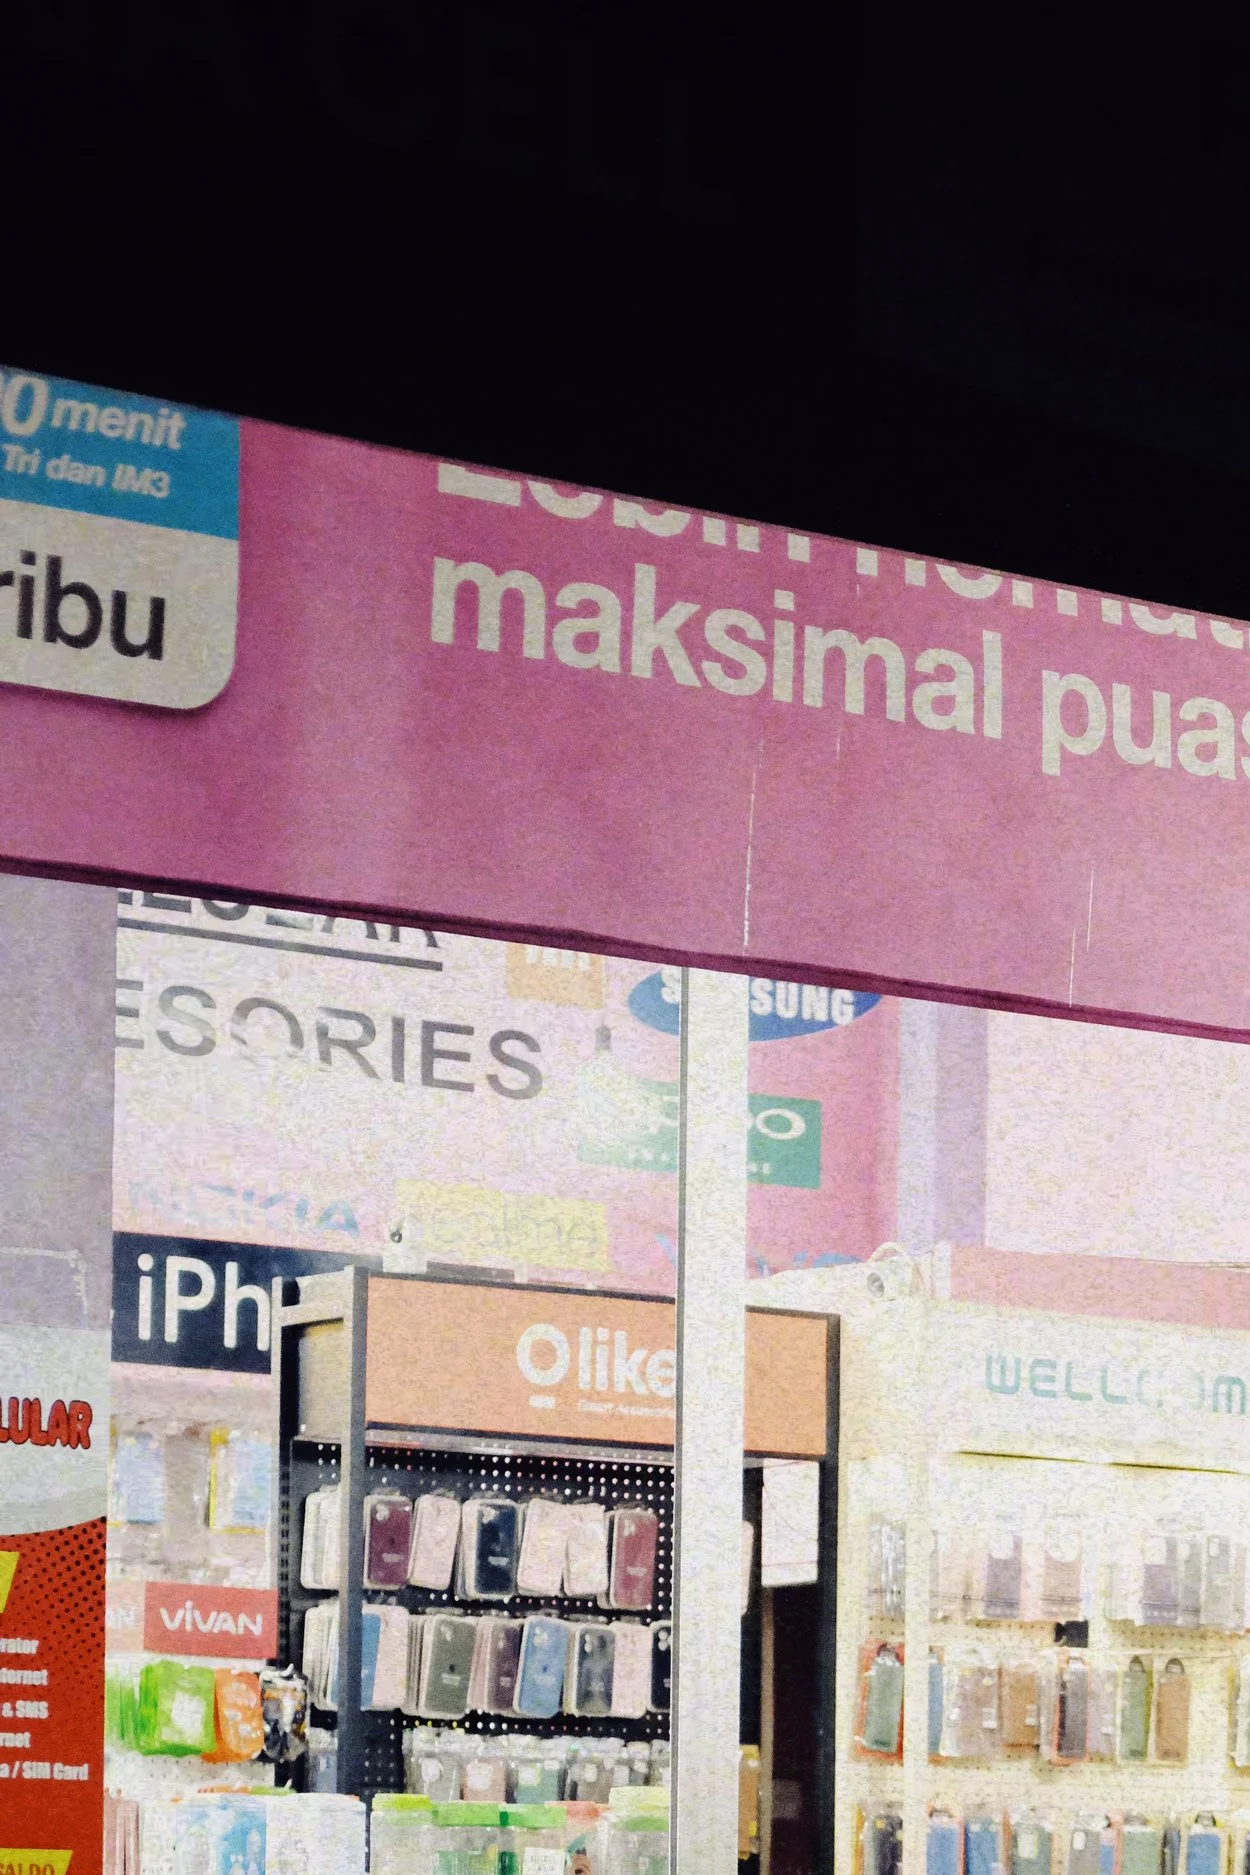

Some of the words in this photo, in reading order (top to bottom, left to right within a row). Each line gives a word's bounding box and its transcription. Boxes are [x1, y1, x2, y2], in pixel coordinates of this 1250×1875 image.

[51, 398, 187, 450] menit
[2, 443, 41, 475] Tri
[46, 453, 107, 488] dan
[112, 463, 170, 498] IM3
[431, 556, 1002, 740] maksimal
[137, 1252, 271, 1351] iPh
[15, 1700, 49, 1719] SMS
